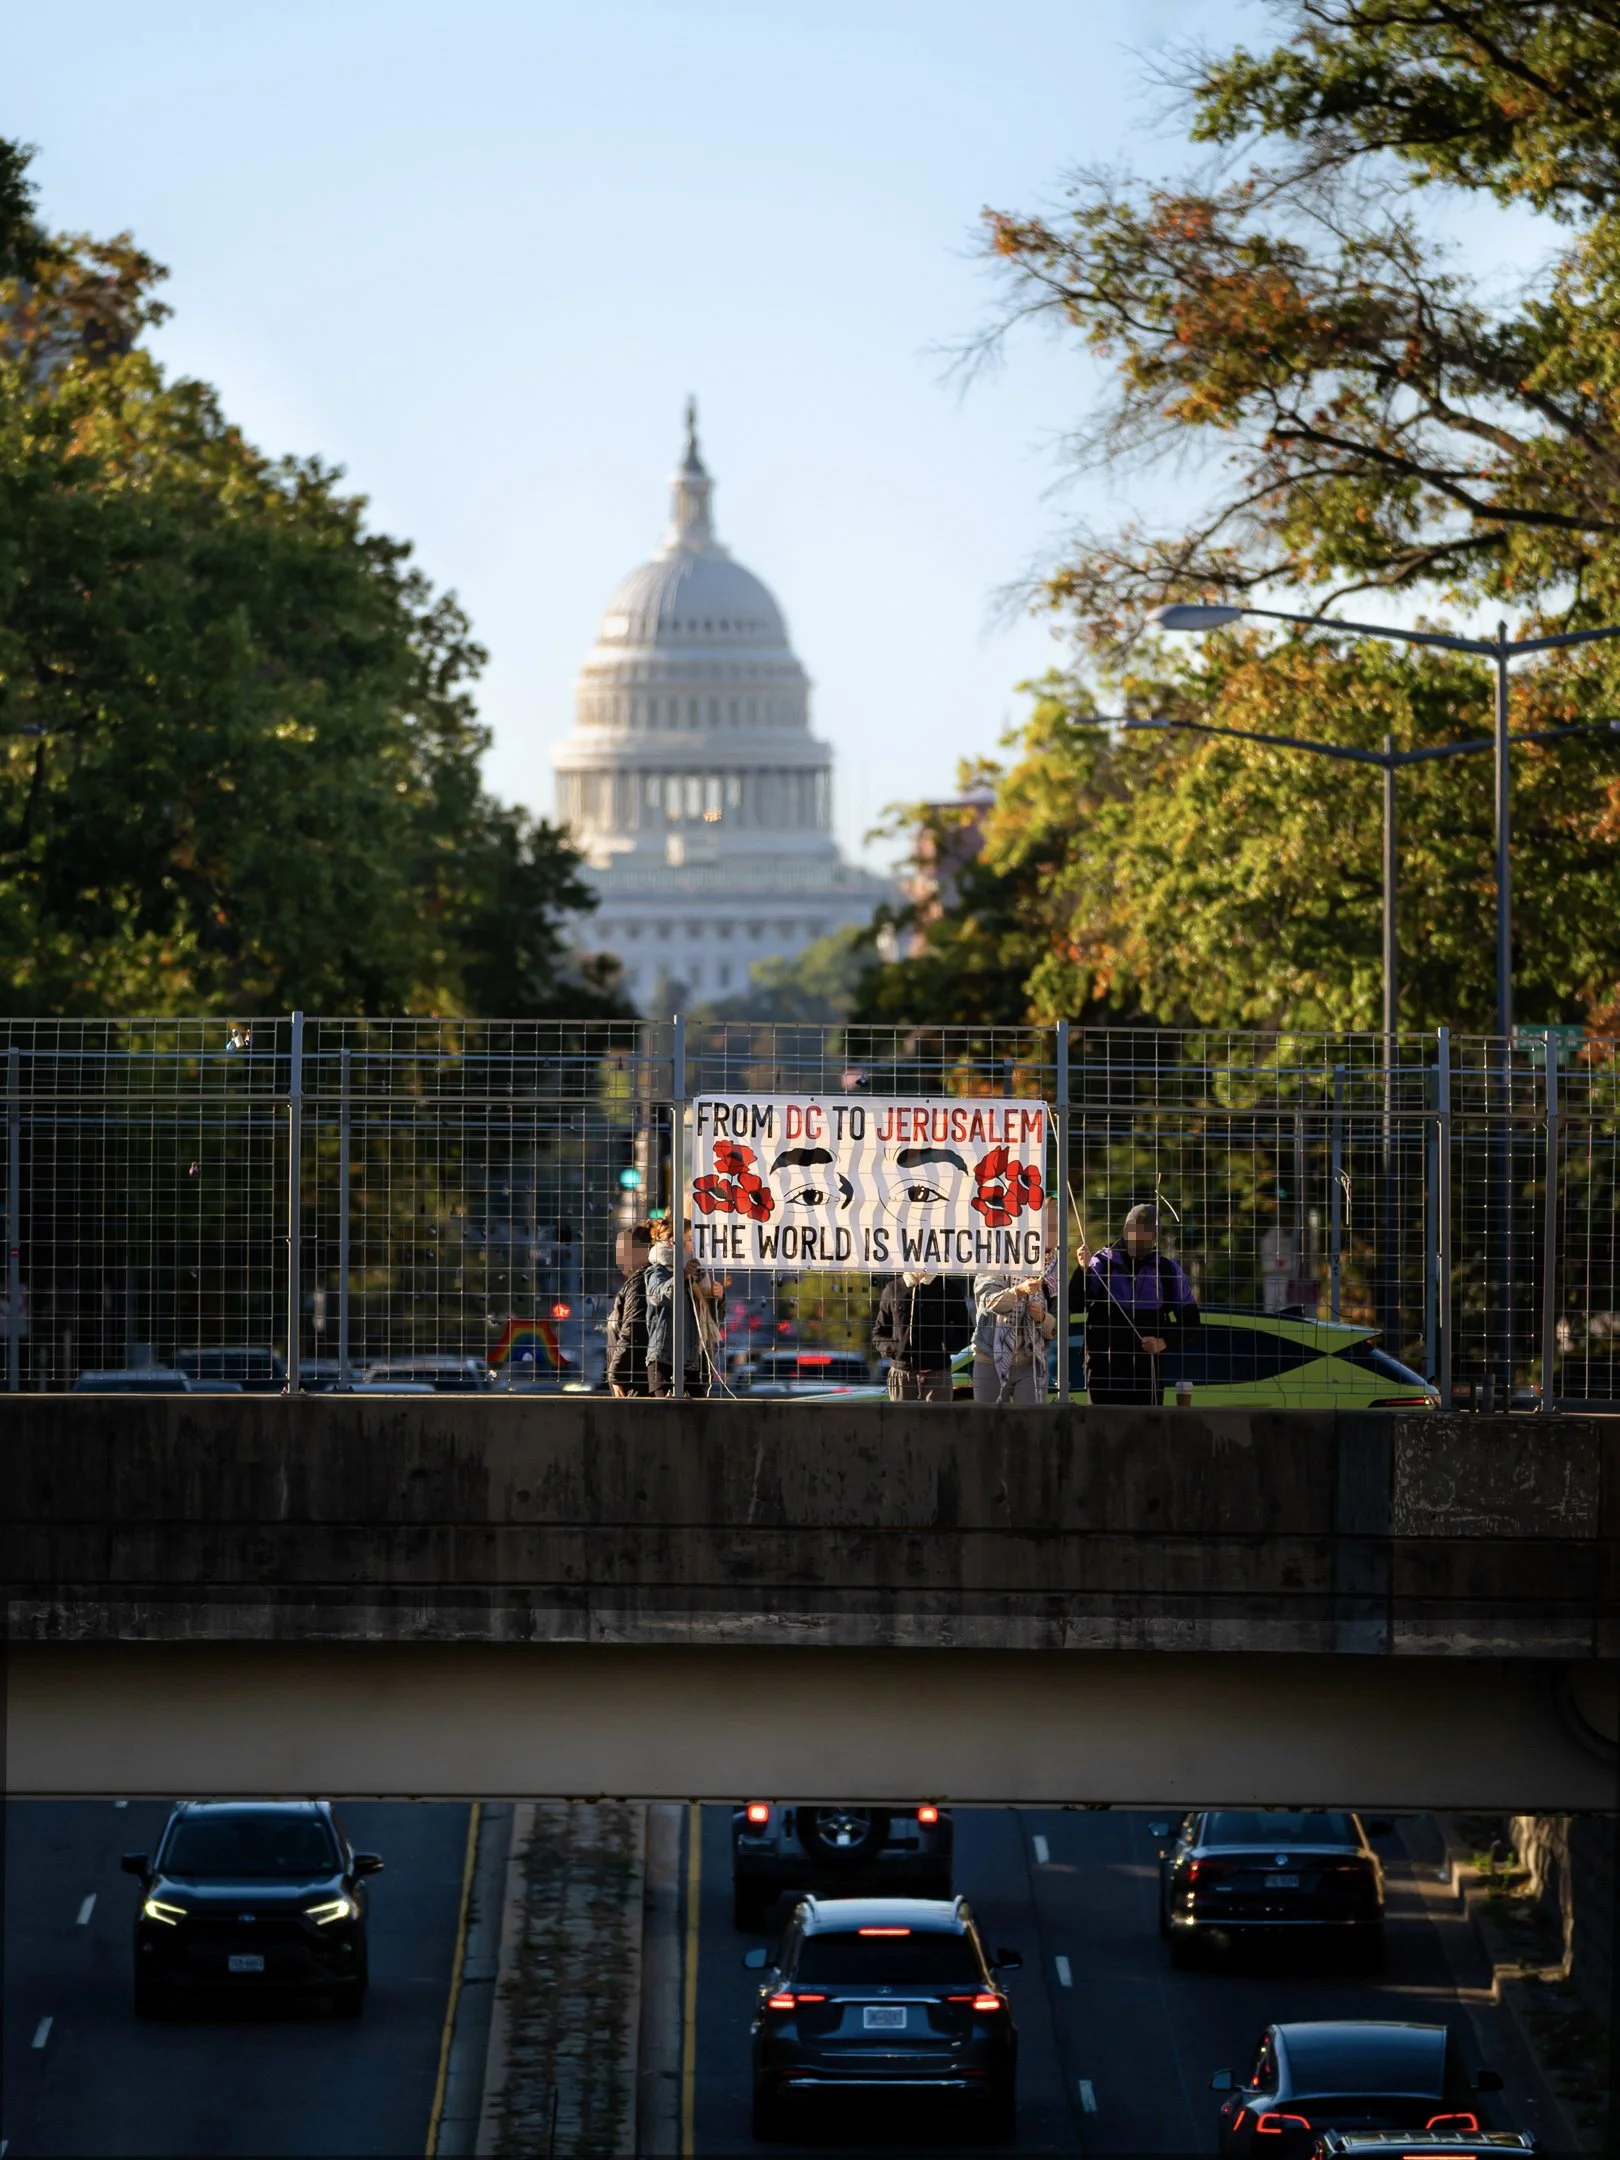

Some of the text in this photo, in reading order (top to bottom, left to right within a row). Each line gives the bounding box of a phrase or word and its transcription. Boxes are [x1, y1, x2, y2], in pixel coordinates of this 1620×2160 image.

[697, 1102, 1043, 1143] FROM DC TO JERUSALEM
[695, 1224, 1041, 1265] THE WORLD IS WATCHING
